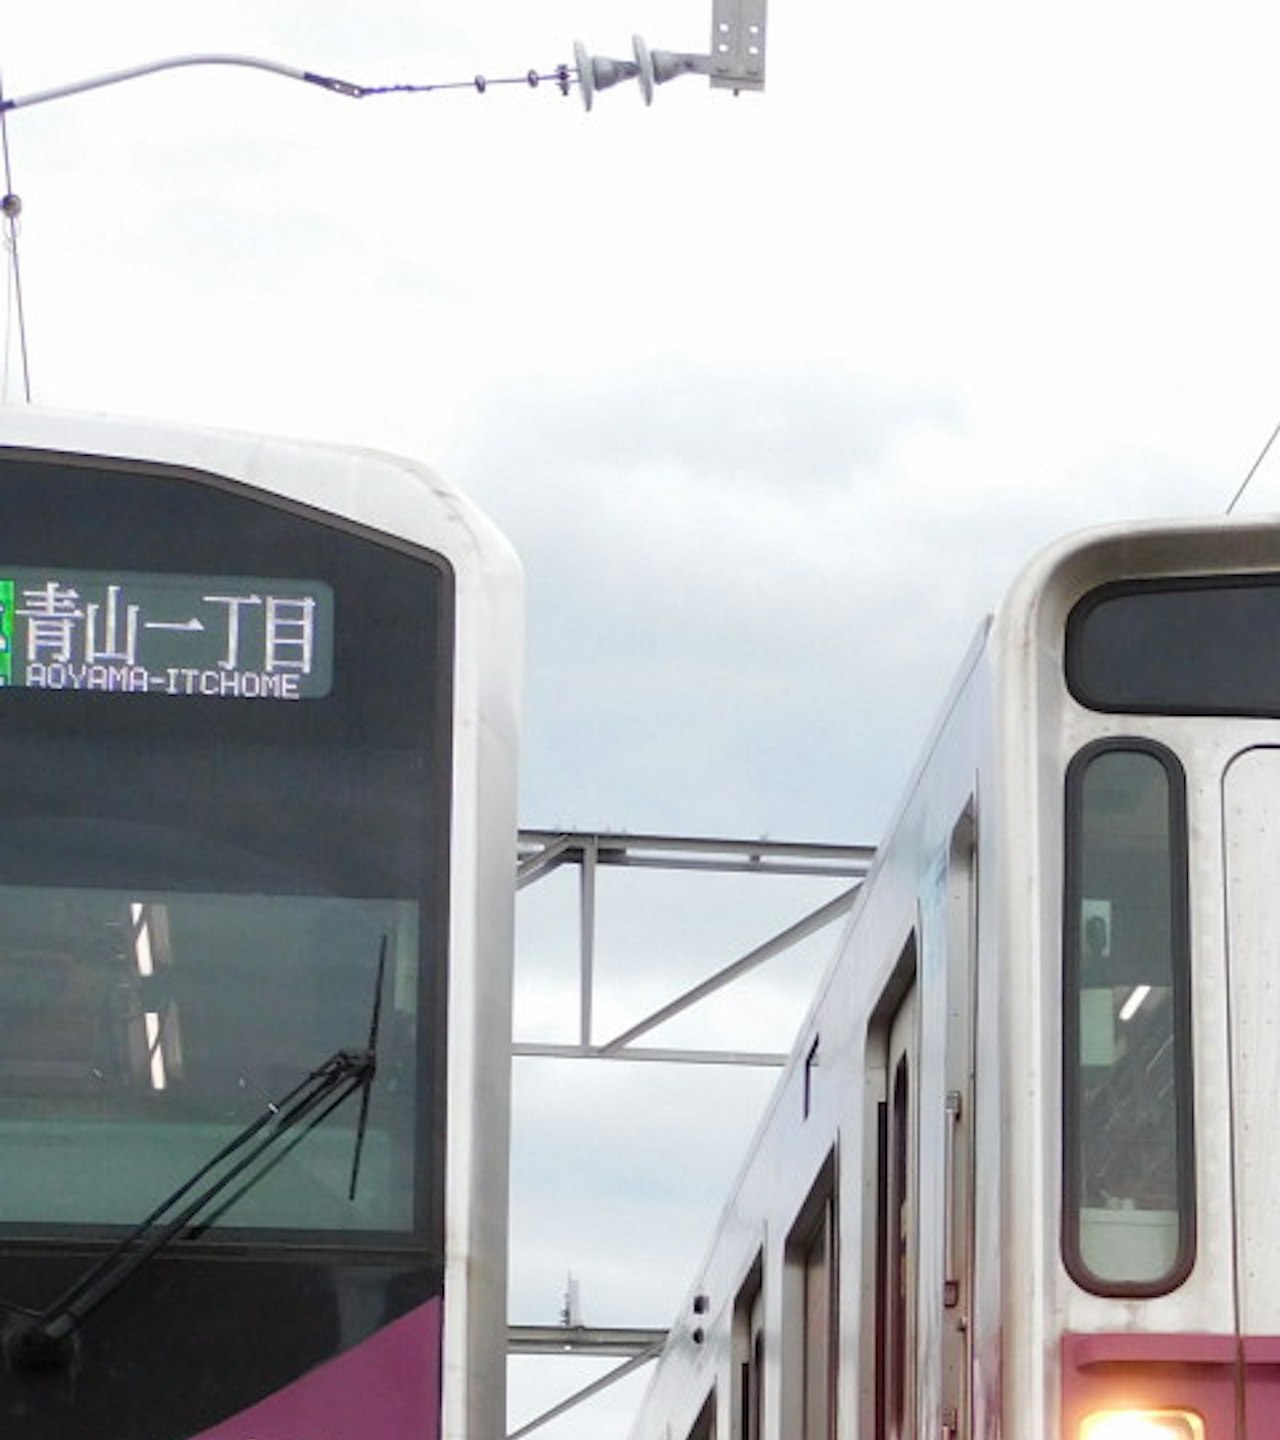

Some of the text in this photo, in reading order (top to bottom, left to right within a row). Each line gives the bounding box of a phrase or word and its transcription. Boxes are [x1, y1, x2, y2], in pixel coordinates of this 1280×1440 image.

[15, 582, 316, 673] 青山一丁目
[25, 663, 301, 699] AOYAMA-ITCHOME
